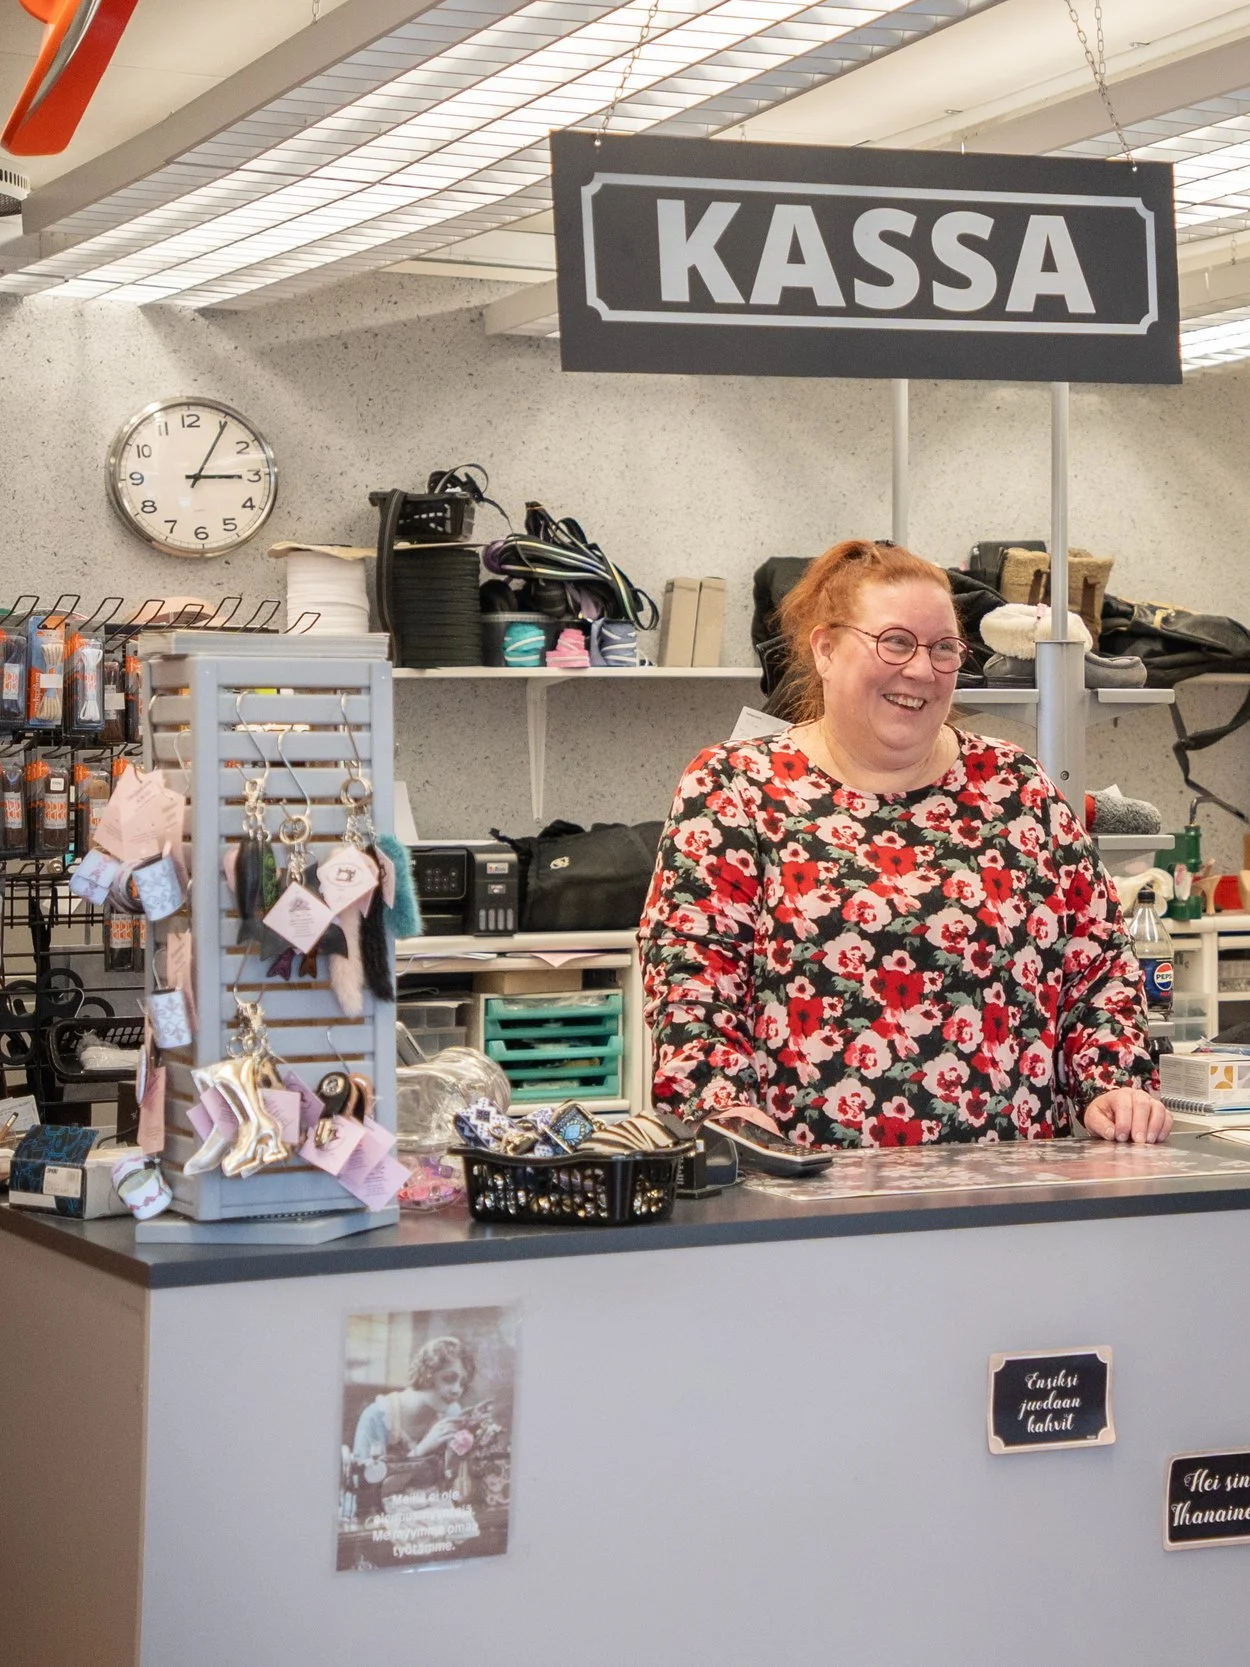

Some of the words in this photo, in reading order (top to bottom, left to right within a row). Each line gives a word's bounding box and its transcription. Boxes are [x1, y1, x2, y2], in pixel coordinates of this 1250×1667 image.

[656, 198, 1096, 316] KASSA
[181, 414, 201, 428] 12
[158, 421, 169, 436] 11
[136, 444, 152, 458] 10
[235, 441, 250, 454] 2
[129, 472, 144, 486] 9
[246, 469, 262, 483] 3
[140, 500, 157, 513] 8
[241, 497, 256, 511] 4
[164, 519, 178, 534] 7
[222, 518, 237, 531] 5
[194, 526, 209, 540] 6
[1024, 1369, 1079, 1390] Ensiksi
[1017, 1390, 1081, 1421] juodaan
[1027, 1413, 1076, 1433] kahvit
[1183, 1468, 1221, 1493] Hei
[372, 1529, 392, 1542] Me
